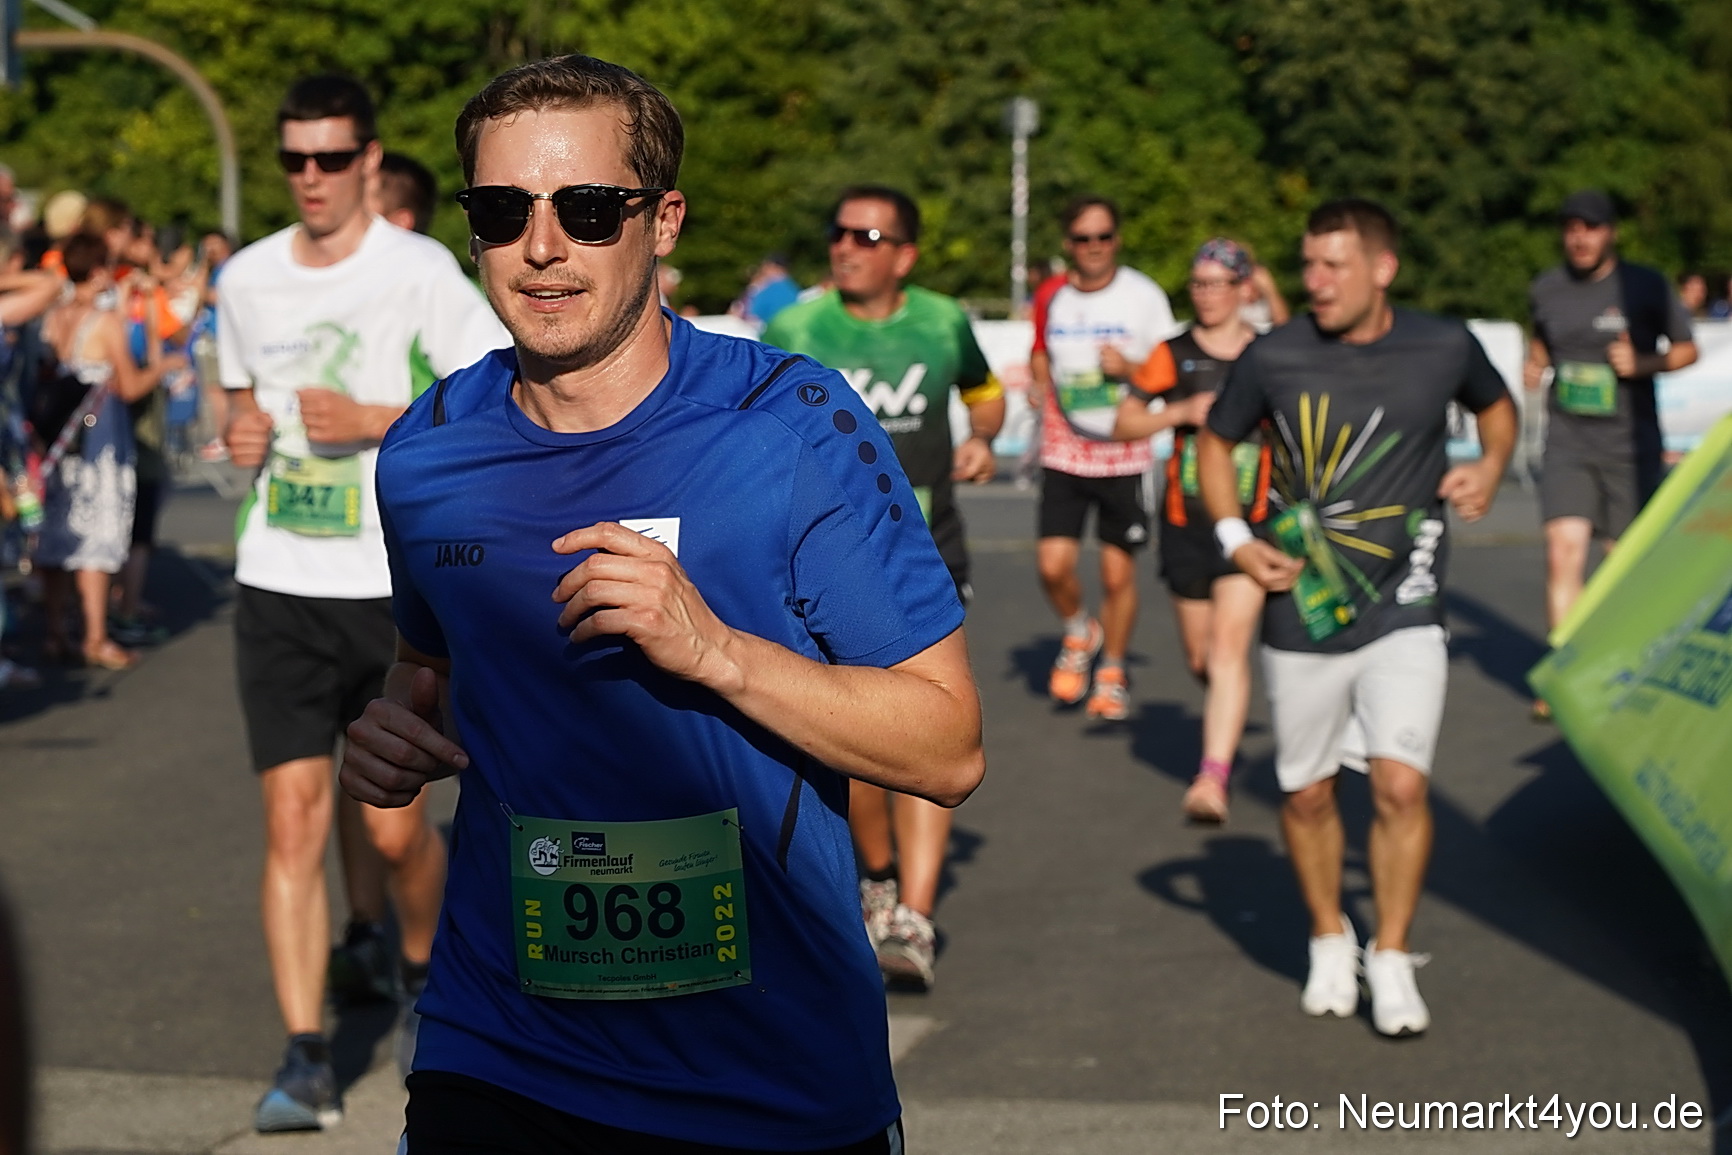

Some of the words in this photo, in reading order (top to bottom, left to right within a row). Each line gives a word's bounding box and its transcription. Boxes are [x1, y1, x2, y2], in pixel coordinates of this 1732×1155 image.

[434, 544, 485, 568] JAKO
[564, 854, 633, 867] Firmenlauf
[590, 866, 633, 875] neumarkt
[563, 882, 686, 941] 968
[713, 882, 737, 962] 2022
[525, 899, 544, 960] RUN
[544, 944, 614, 964] Mursch
[621, 942, 715, 963] Christian
[633, 973, 656, 981] GmbH
